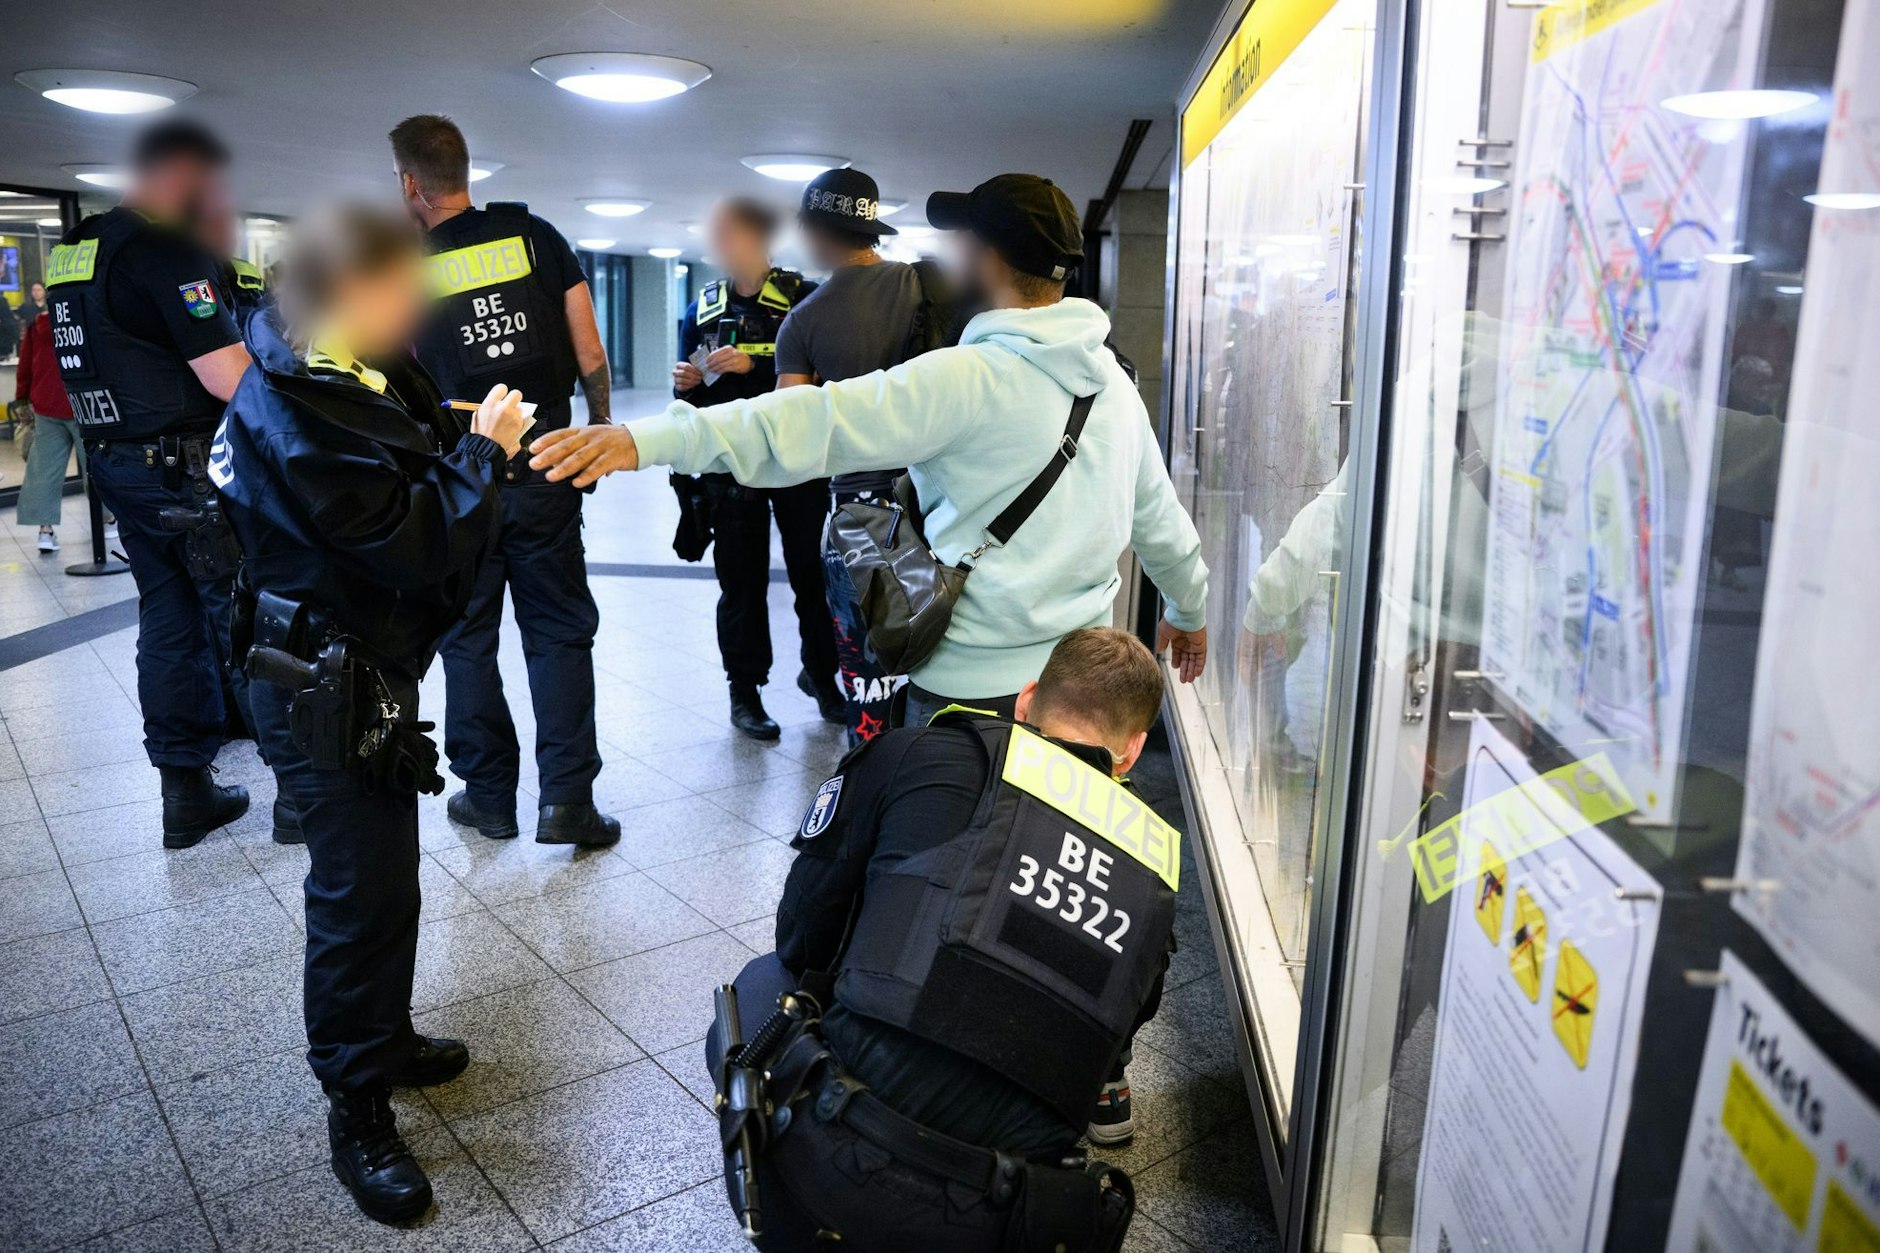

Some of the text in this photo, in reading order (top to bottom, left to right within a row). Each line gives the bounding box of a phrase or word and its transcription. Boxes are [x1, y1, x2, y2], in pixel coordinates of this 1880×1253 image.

[55, 302, 71, 323] BE
[460, 311, 527, 345] 35320
[472, 293, 505, 318] BE
[1011, 734, 1174, 878] POLIZEI
[1058, 831, 1114, 891] BE
[1009, 854, 1131, 954] 35322
[1737, 1001, 1824, 1135] Tickets
